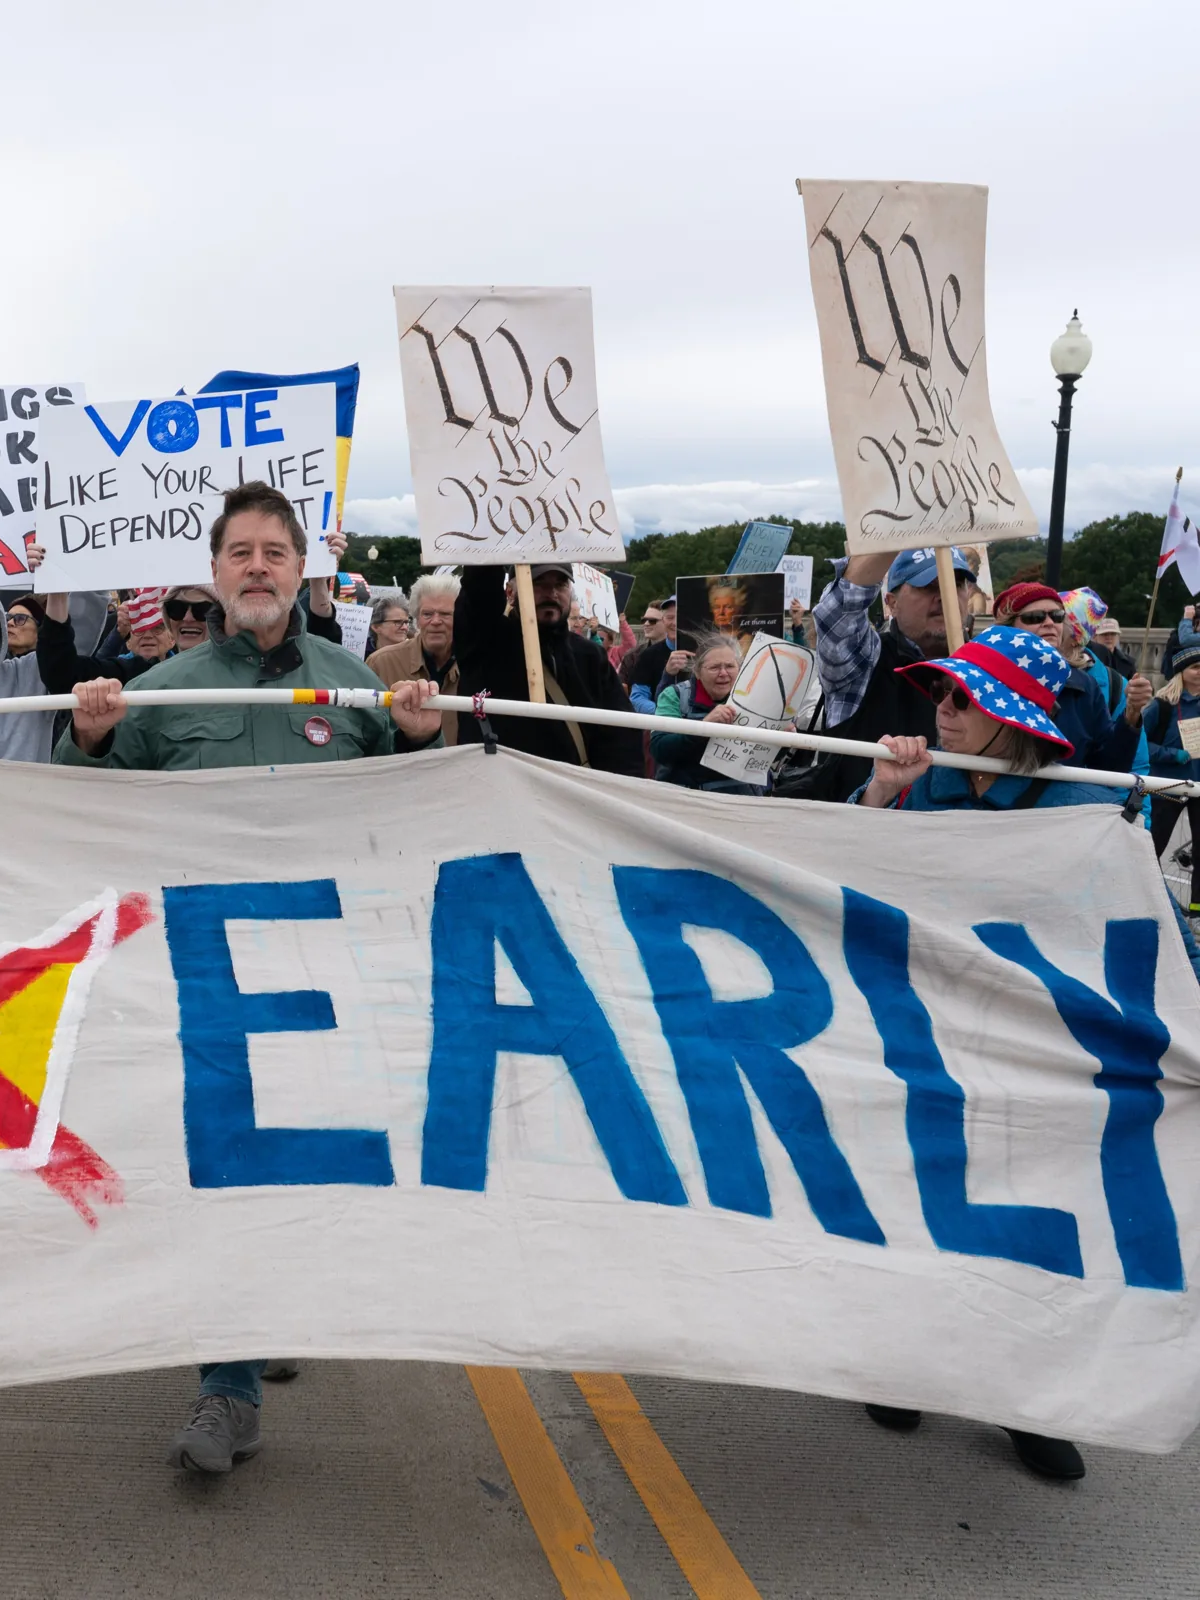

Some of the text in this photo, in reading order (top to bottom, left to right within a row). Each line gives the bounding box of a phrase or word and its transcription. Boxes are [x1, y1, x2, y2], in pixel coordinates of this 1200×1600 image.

[810, 193, 984, 402] We
[400, 298, 598, 452] We
[899, 363, 964, 448] the
[84, 389, 285, 457] VOTE
[486, 422, 565, 487] the
[44, 460, 118, 509] LIKE
[141, 461, 220, 499] YOUR
[435, 477, 616, 550] People
[857, 432, 1016, 535] People
[59, 502, 204, 554] DEPENDS
[739, 619, 750, 627] Let
[751, 617, 766, 625] them
[713, 743, 740, 763] THE
[161, 850, 1185, 1293] EARLY
